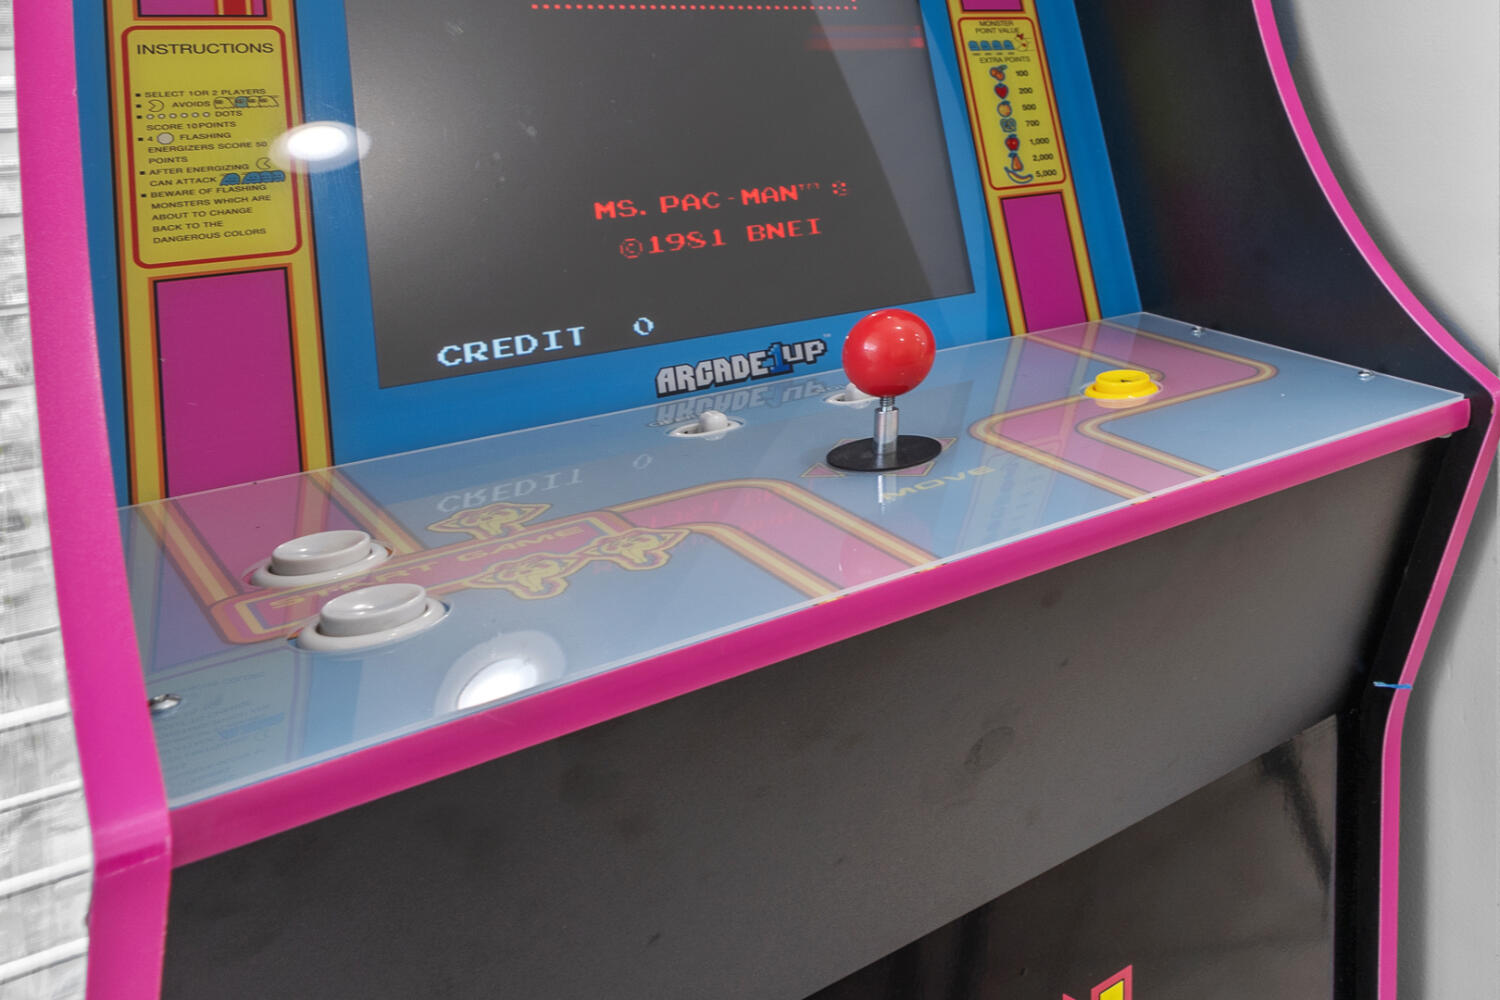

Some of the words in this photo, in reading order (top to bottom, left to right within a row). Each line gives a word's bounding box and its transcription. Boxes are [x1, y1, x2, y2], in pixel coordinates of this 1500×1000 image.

[136, 42, 275, 55] INSTRUCTIONS
[146, 123, 183, 131] SCORE
[180, 132, 231, 140] FLASHING
[148, 143, 215, 153] ENERGIZERS
[218, 141, 252, 149] SCORE
[148, 156, 189, 164] POINTS
[186, 164, 249, 173] ENERGIZING
[149, 179, 173, 187] CAN
[176, 177, 217, 185] ATTACK
[151, 189, 195, 198] BEWARE
[216, 184, 267, 193] FLASHING
[151, 200, 210, 209] MONSTERS
[213, 197, 249, 205] WHICH
[151, 212, 188, 221] ABOUT
[209, 207, 253, 217] CHANGE
[594, 200, 647, 220] MS.
[152, 224, 183, 233] BACK
[747, 218, 822, 242] BNEI
[153, 232, 221, 244] DANGEROUS
[223, 228, 267, 237] COLORS
[437, 326, 585, 367] CREDIT
[633, 317, 654, 336] 0
[655, 338, 827, 398] ARCADE1UP
